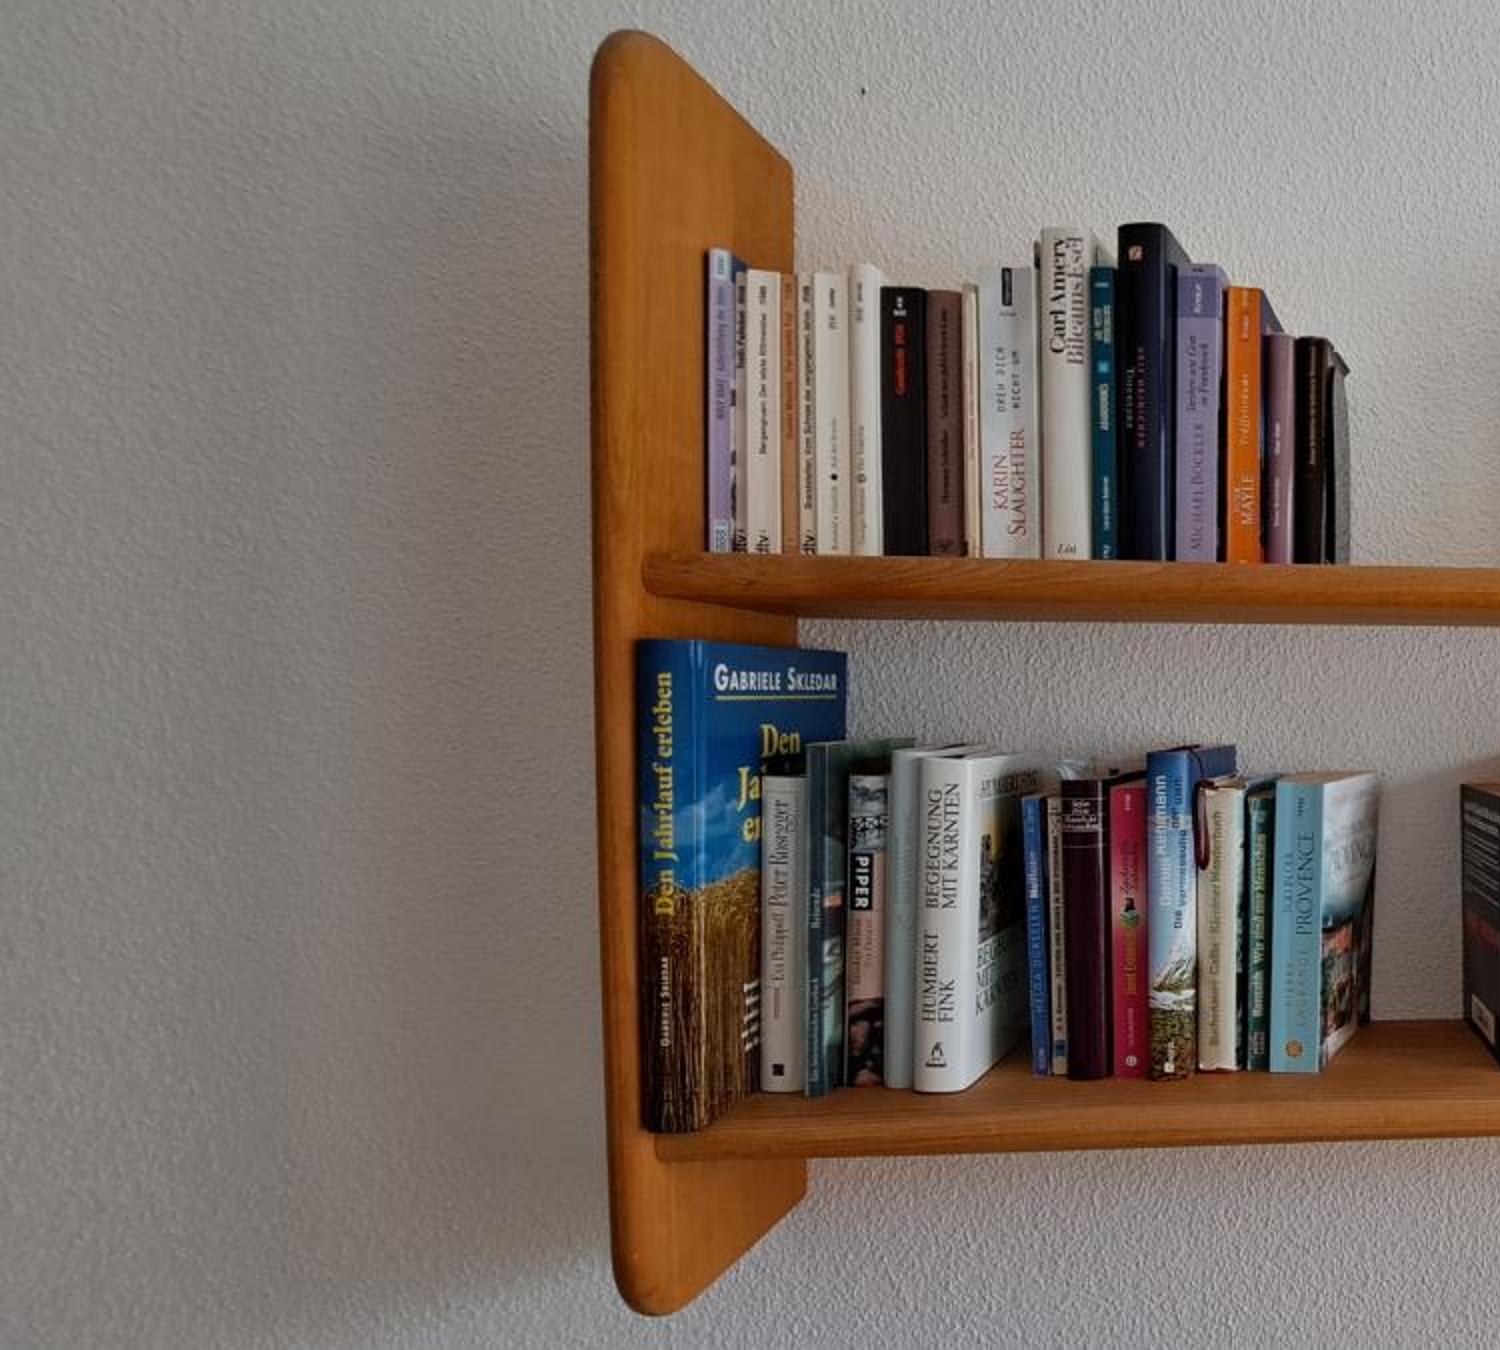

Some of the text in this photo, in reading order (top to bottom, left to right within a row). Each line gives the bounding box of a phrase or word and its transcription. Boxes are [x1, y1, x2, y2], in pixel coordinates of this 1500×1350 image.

[1049, 238, 1070, 354] Carl Amery
[1066, 236, 1085, 365] Bileams Esel
[992, 454, 1009, 512] KARIN
[1007, 427, 1027, 537] SLAUGHTER
[1190, 490, 1205, 550] MICHAEL
[714, 663, 837, 691] GABRIELE SKLEDAR
[760, 723, 801, 758] Den
[652, 671, 679, 916] Den Jahrlauf erleben
[1154, 774, 1168, 856] Kehlmann
[768, 799, 796, 866] Rosegger
[924, 789, 943, 910] BEGEGNUNG
[768, 870, 788, 908] Peter
[854, 855, 870, 909] PIPER
[942, 873, 959, 910] MIT
[1296, 831, 1315, 936] PROVENCE
[1173, 910, 1183, 929] Die
[921, 929, 939, 1024] HUMBERT
[937, 978, 956, 1024] FINK
